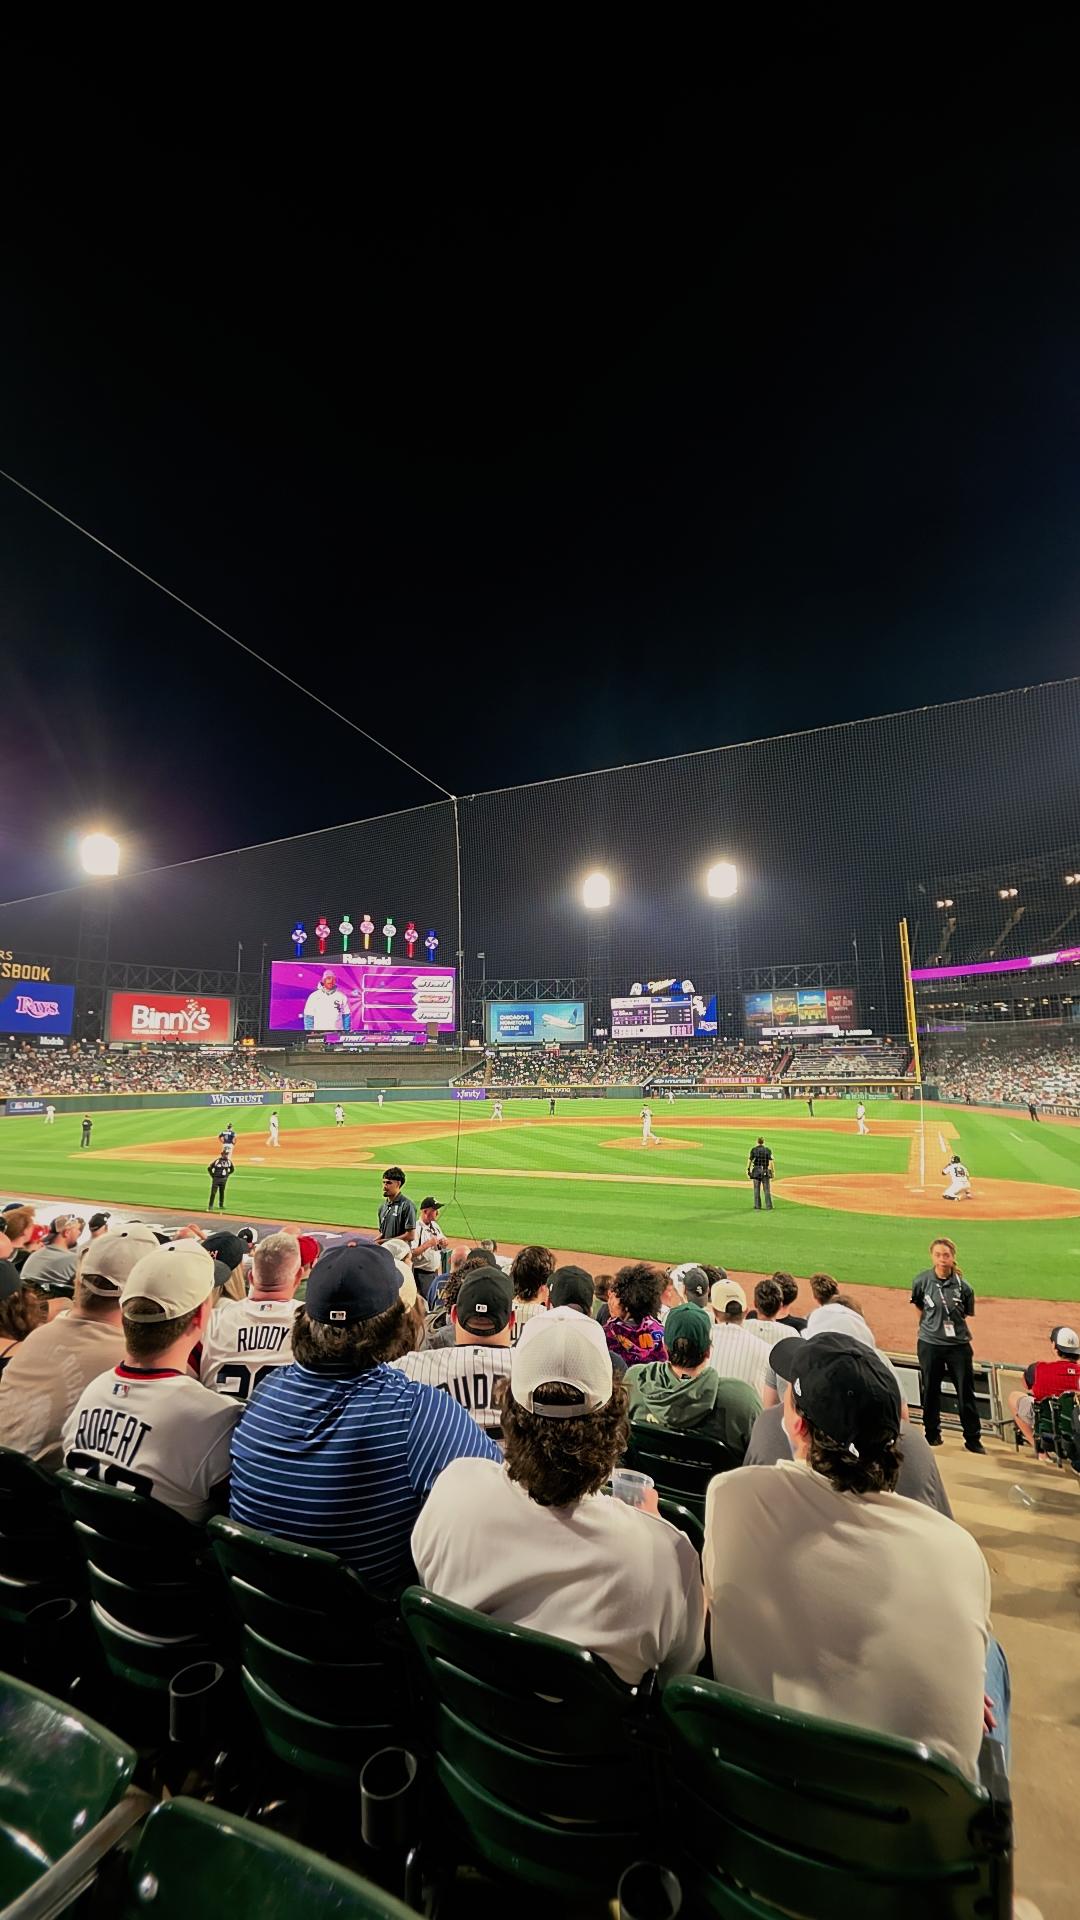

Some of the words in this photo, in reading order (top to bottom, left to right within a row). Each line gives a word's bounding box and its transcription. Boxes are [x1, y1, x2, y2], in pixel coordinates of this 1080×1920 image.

[342, 954, 367, 965] Rate
[367, 956, 391, 966] Field
[0, 963, 51, 982] SBOOK
[210, 1094, 264, 1104] WINTRUST
[456, 1090, 481, 1100] xfinity
[238, 1325, 290, 1352] RUDDY
[75, 1408, 152, 1468] ROBERT
